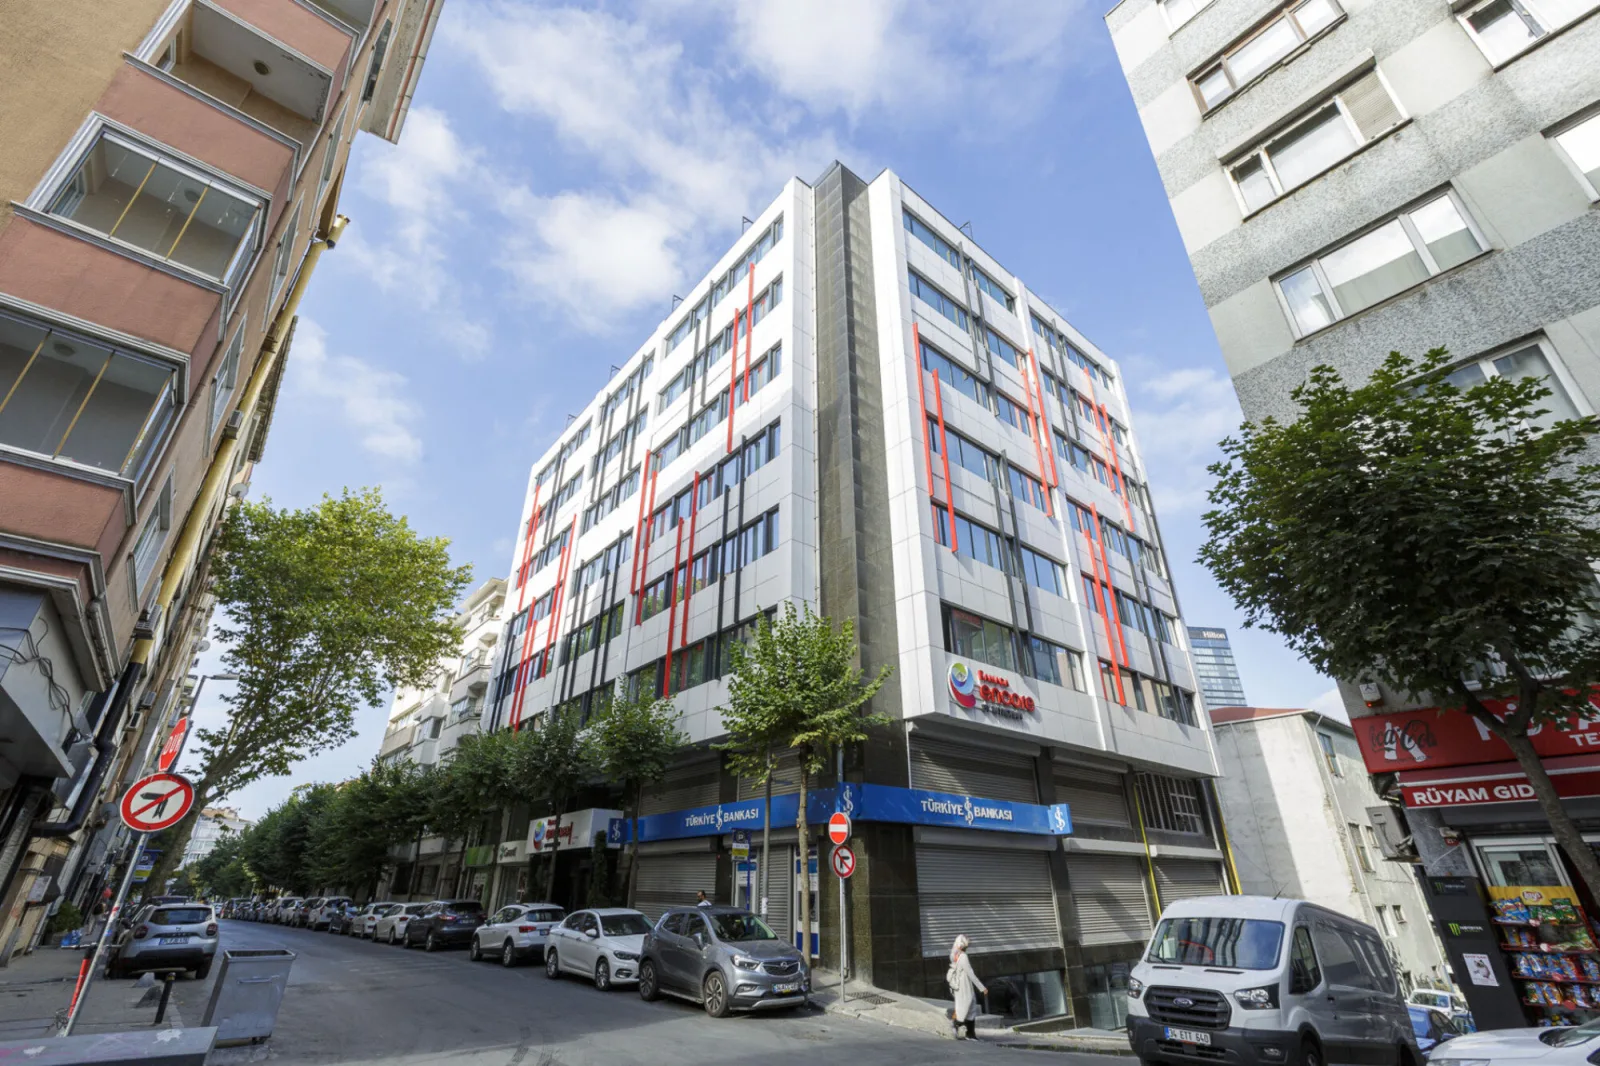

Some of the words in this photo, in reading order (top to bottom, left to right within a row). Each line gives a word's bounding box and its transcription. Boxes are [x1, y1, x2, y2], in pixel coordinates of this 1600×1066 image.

[1202, 630, 1226, 640] Hilton
[979, 684, 1036, 712] encore
[160, 732, 185, 756] DUR
[1568, 732, 1600, 747] TE
[1412, 787, 1490, 805] RÜYAM
[1493, 784, 1536, 800] GID
[685, 812, 716, 828] TÜRKİYE
[723, 808, 759, 823] BANKASI
[920, 798, 964, 816] TÜRKİYE
[974, 806, 1013, 821] BANKASI
[1179, 1030, 1192, 1041] ETT
